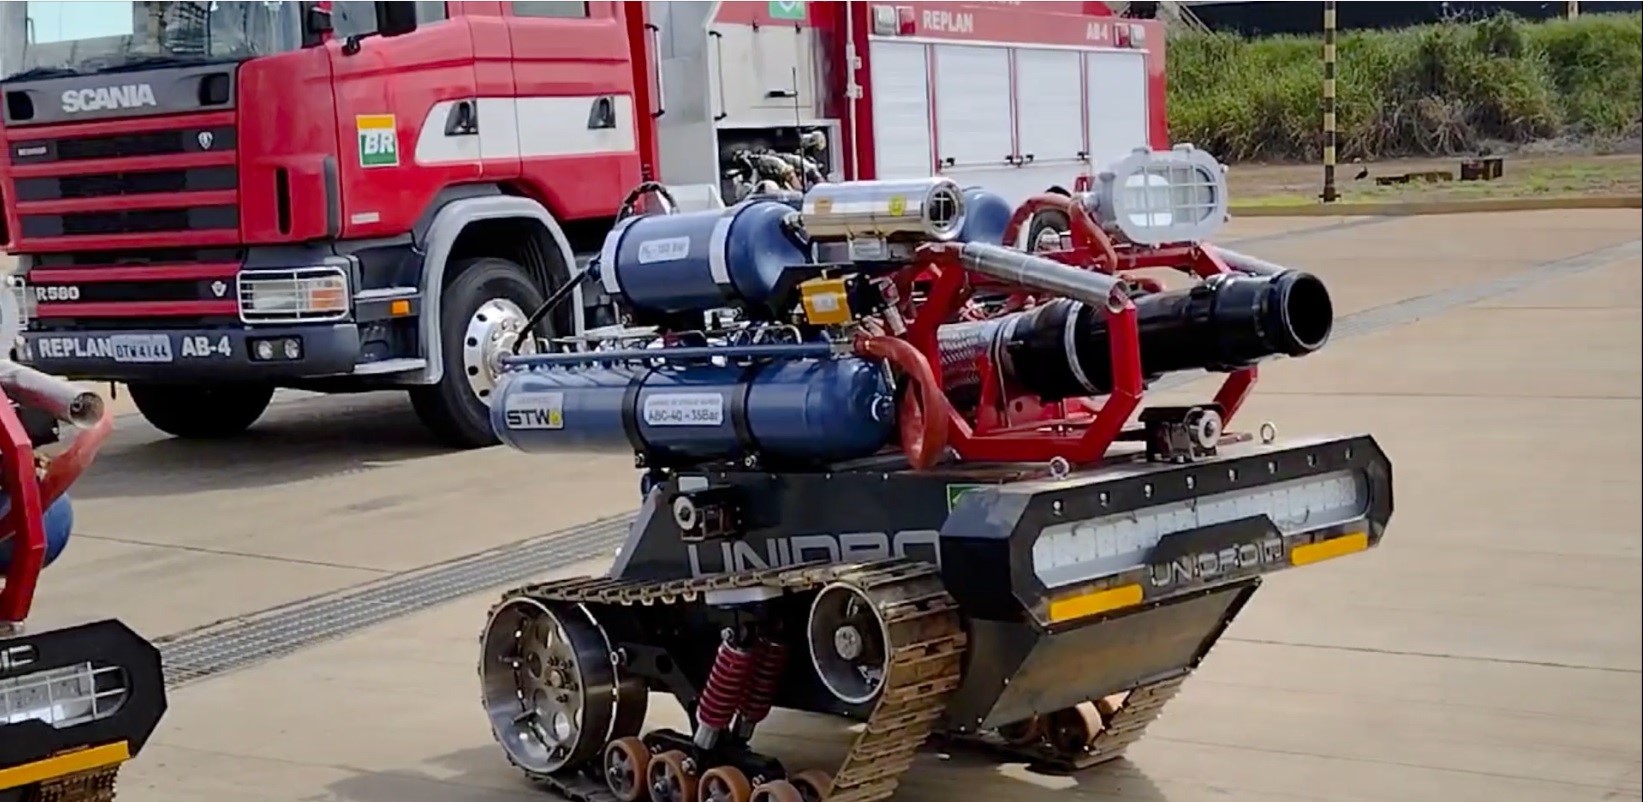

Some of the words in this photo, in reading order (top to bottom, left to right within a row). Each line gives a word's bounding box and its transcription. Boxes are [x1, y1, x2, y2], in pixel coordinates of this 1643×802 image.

[922, 10, 973, 32] REPLAN
[61, 83, 157, 112] SCANIA
[364, 131, 395, 154] BR
[36, 286, 80, 300] R580
[38, 337, 113, 358] REPLAN
[182, 336, 232, 357] AB-4
